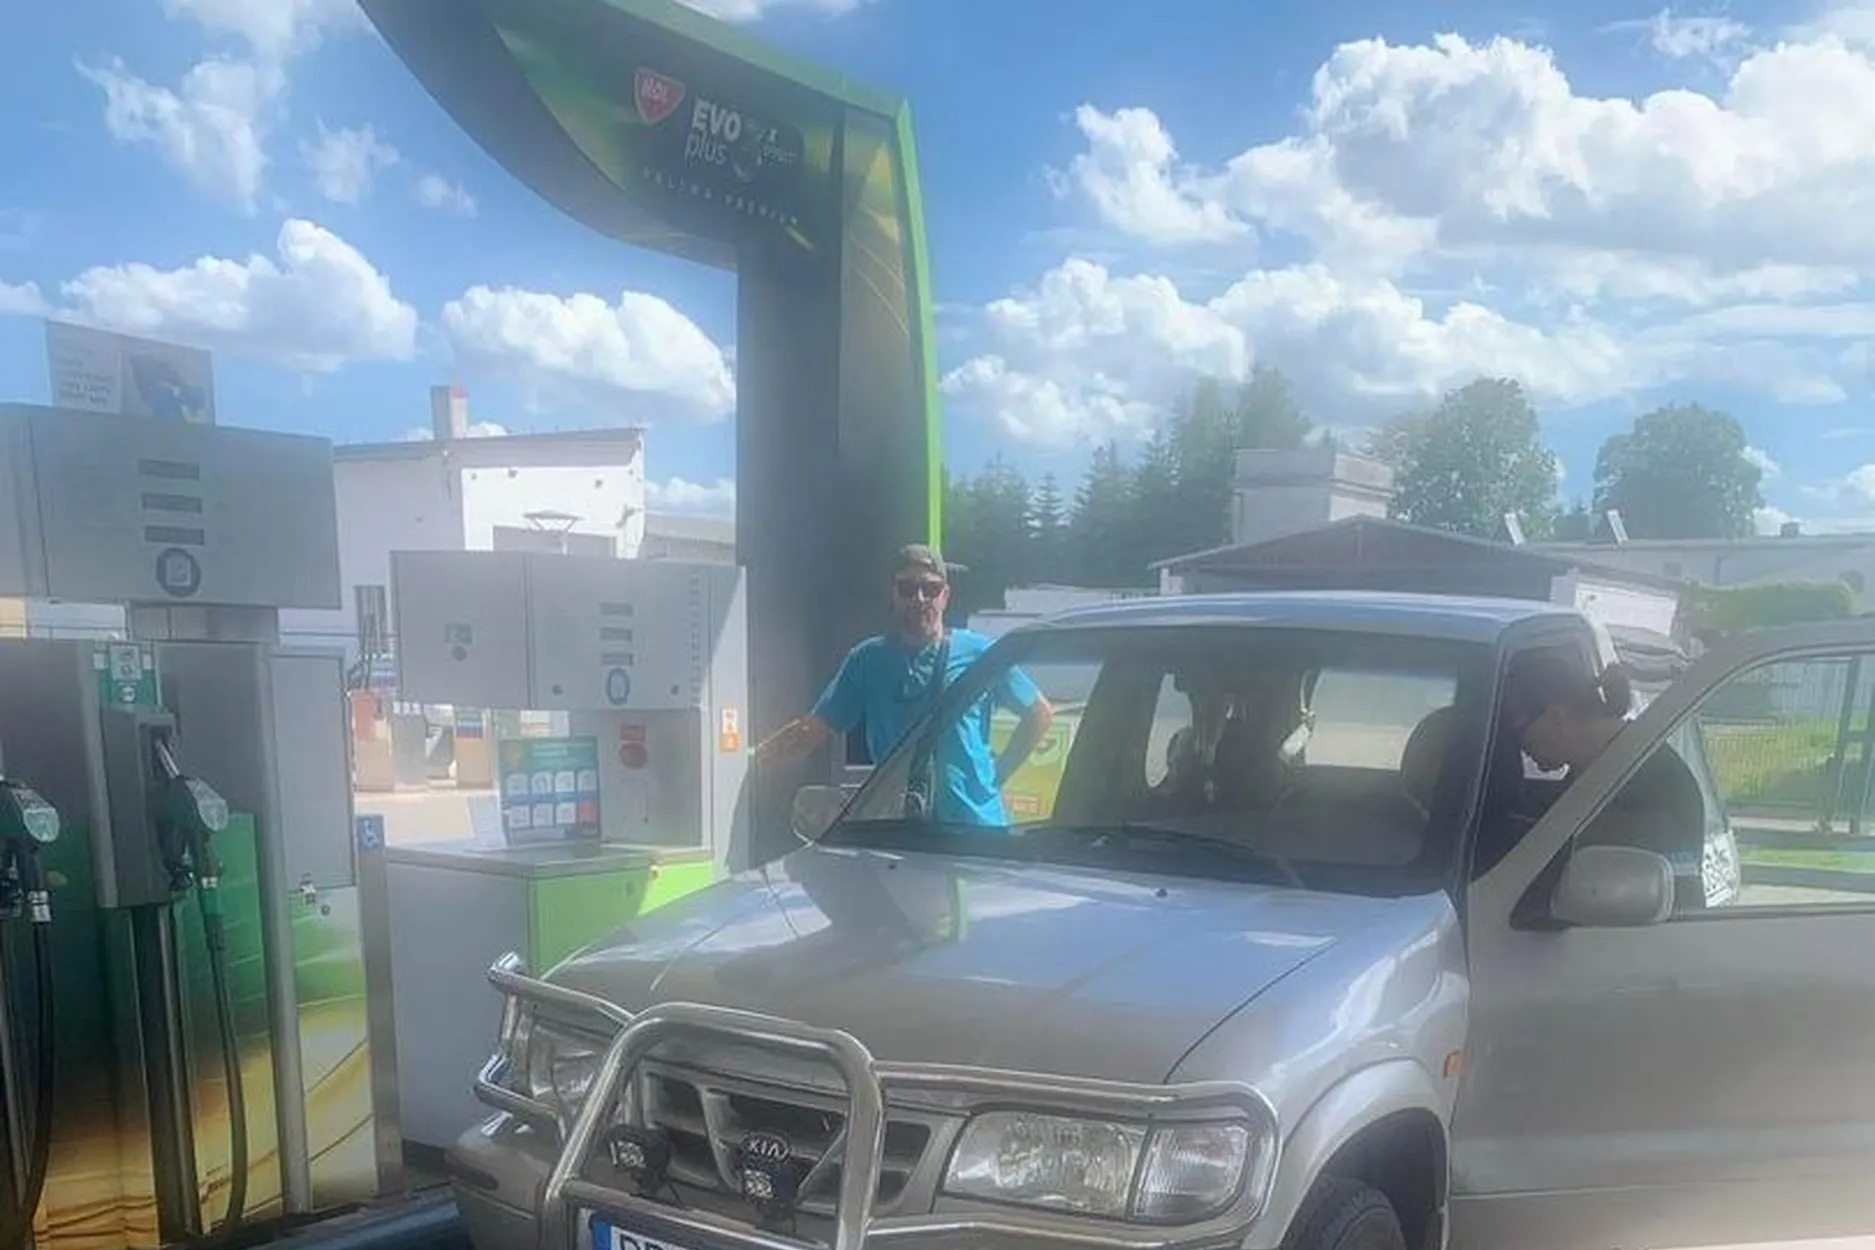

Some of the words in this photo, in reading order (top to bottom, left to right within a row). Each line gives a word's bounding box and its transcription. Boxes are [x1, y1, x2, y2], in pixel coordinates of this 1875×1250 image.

[691, 98, 742, 143] EVO
[685, 130, 728, 168] plus
[747, 1138, 791, 1161] KIA
